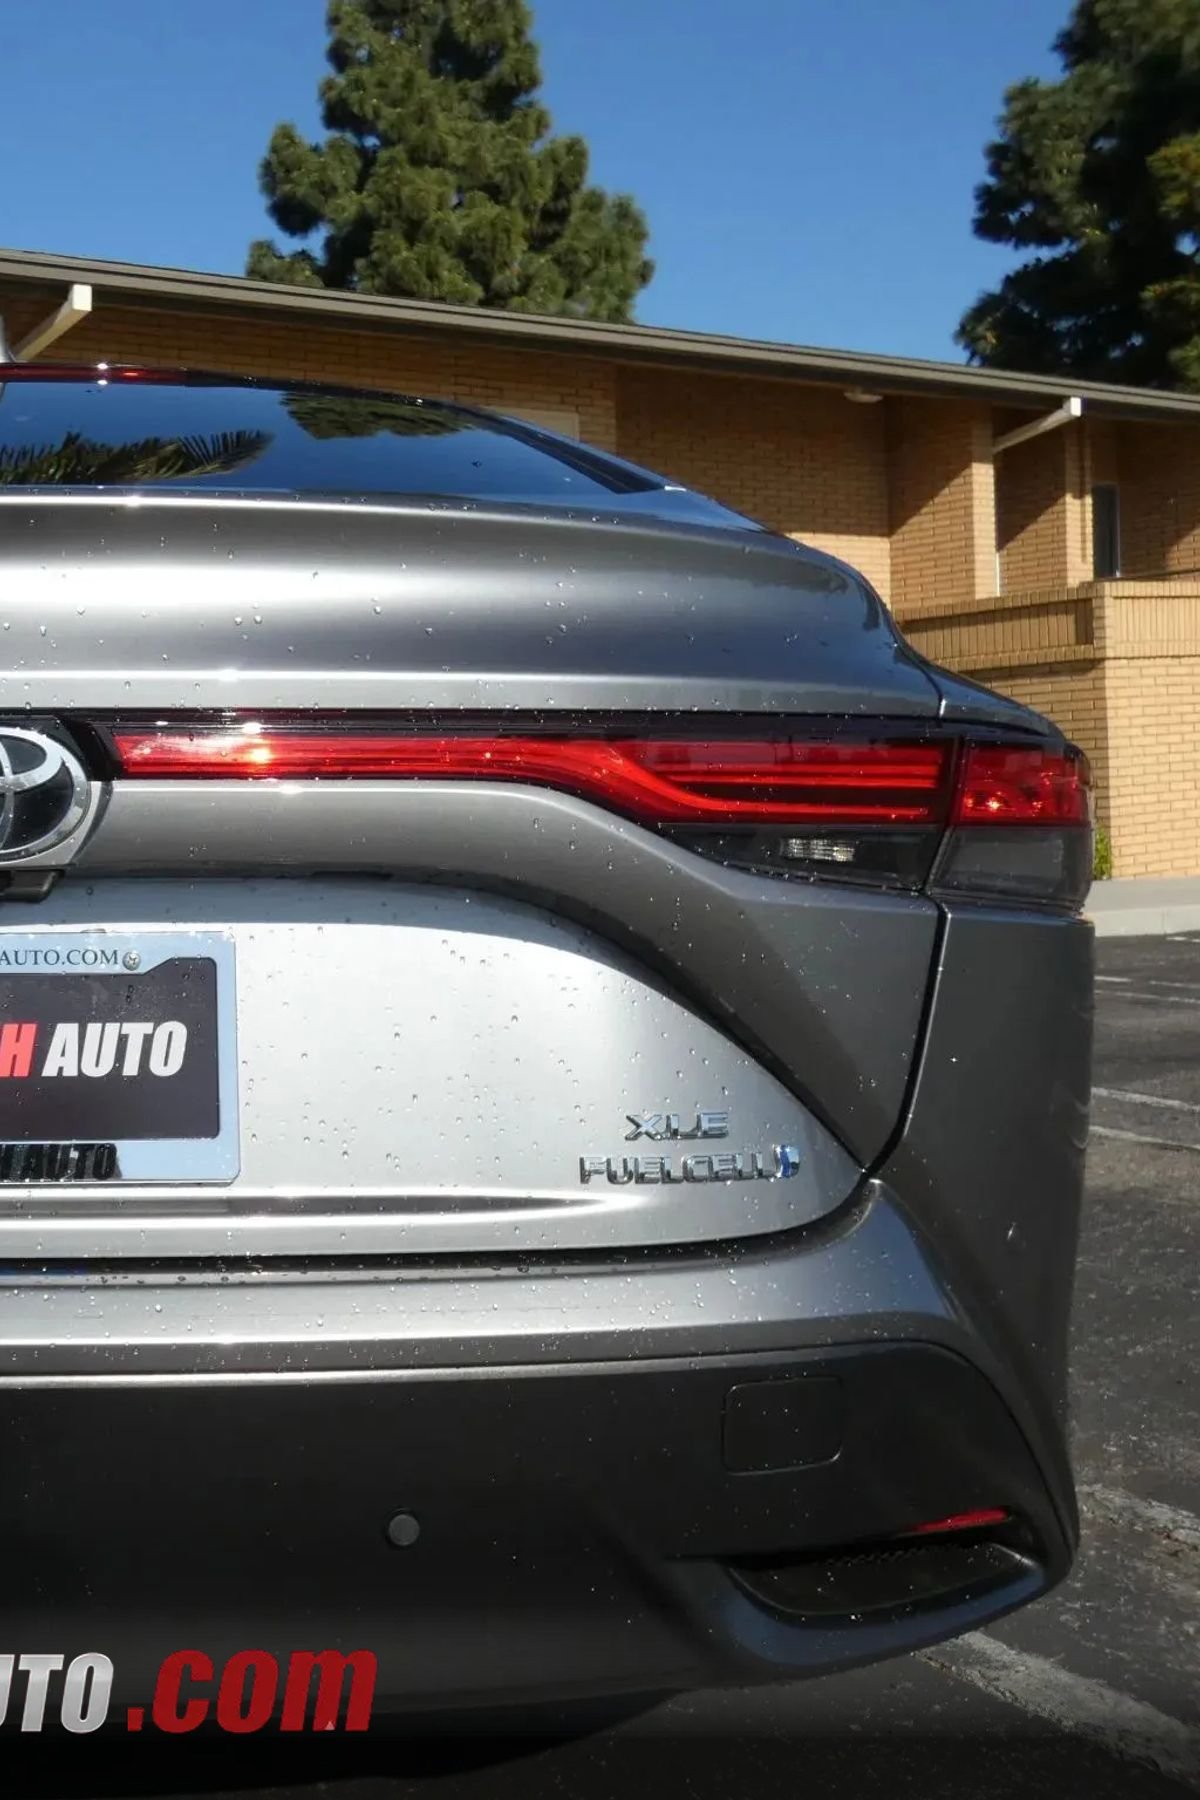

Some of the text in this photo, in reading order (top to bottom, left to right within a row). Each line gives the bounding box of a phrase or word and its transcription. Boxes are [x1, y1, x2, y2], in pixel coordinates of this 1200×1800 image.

[42, 1021, 188, 1077] AUTO
[624, 1112, 729, 1141] XLE
[13, 1143, 120, 1181] AUTO
